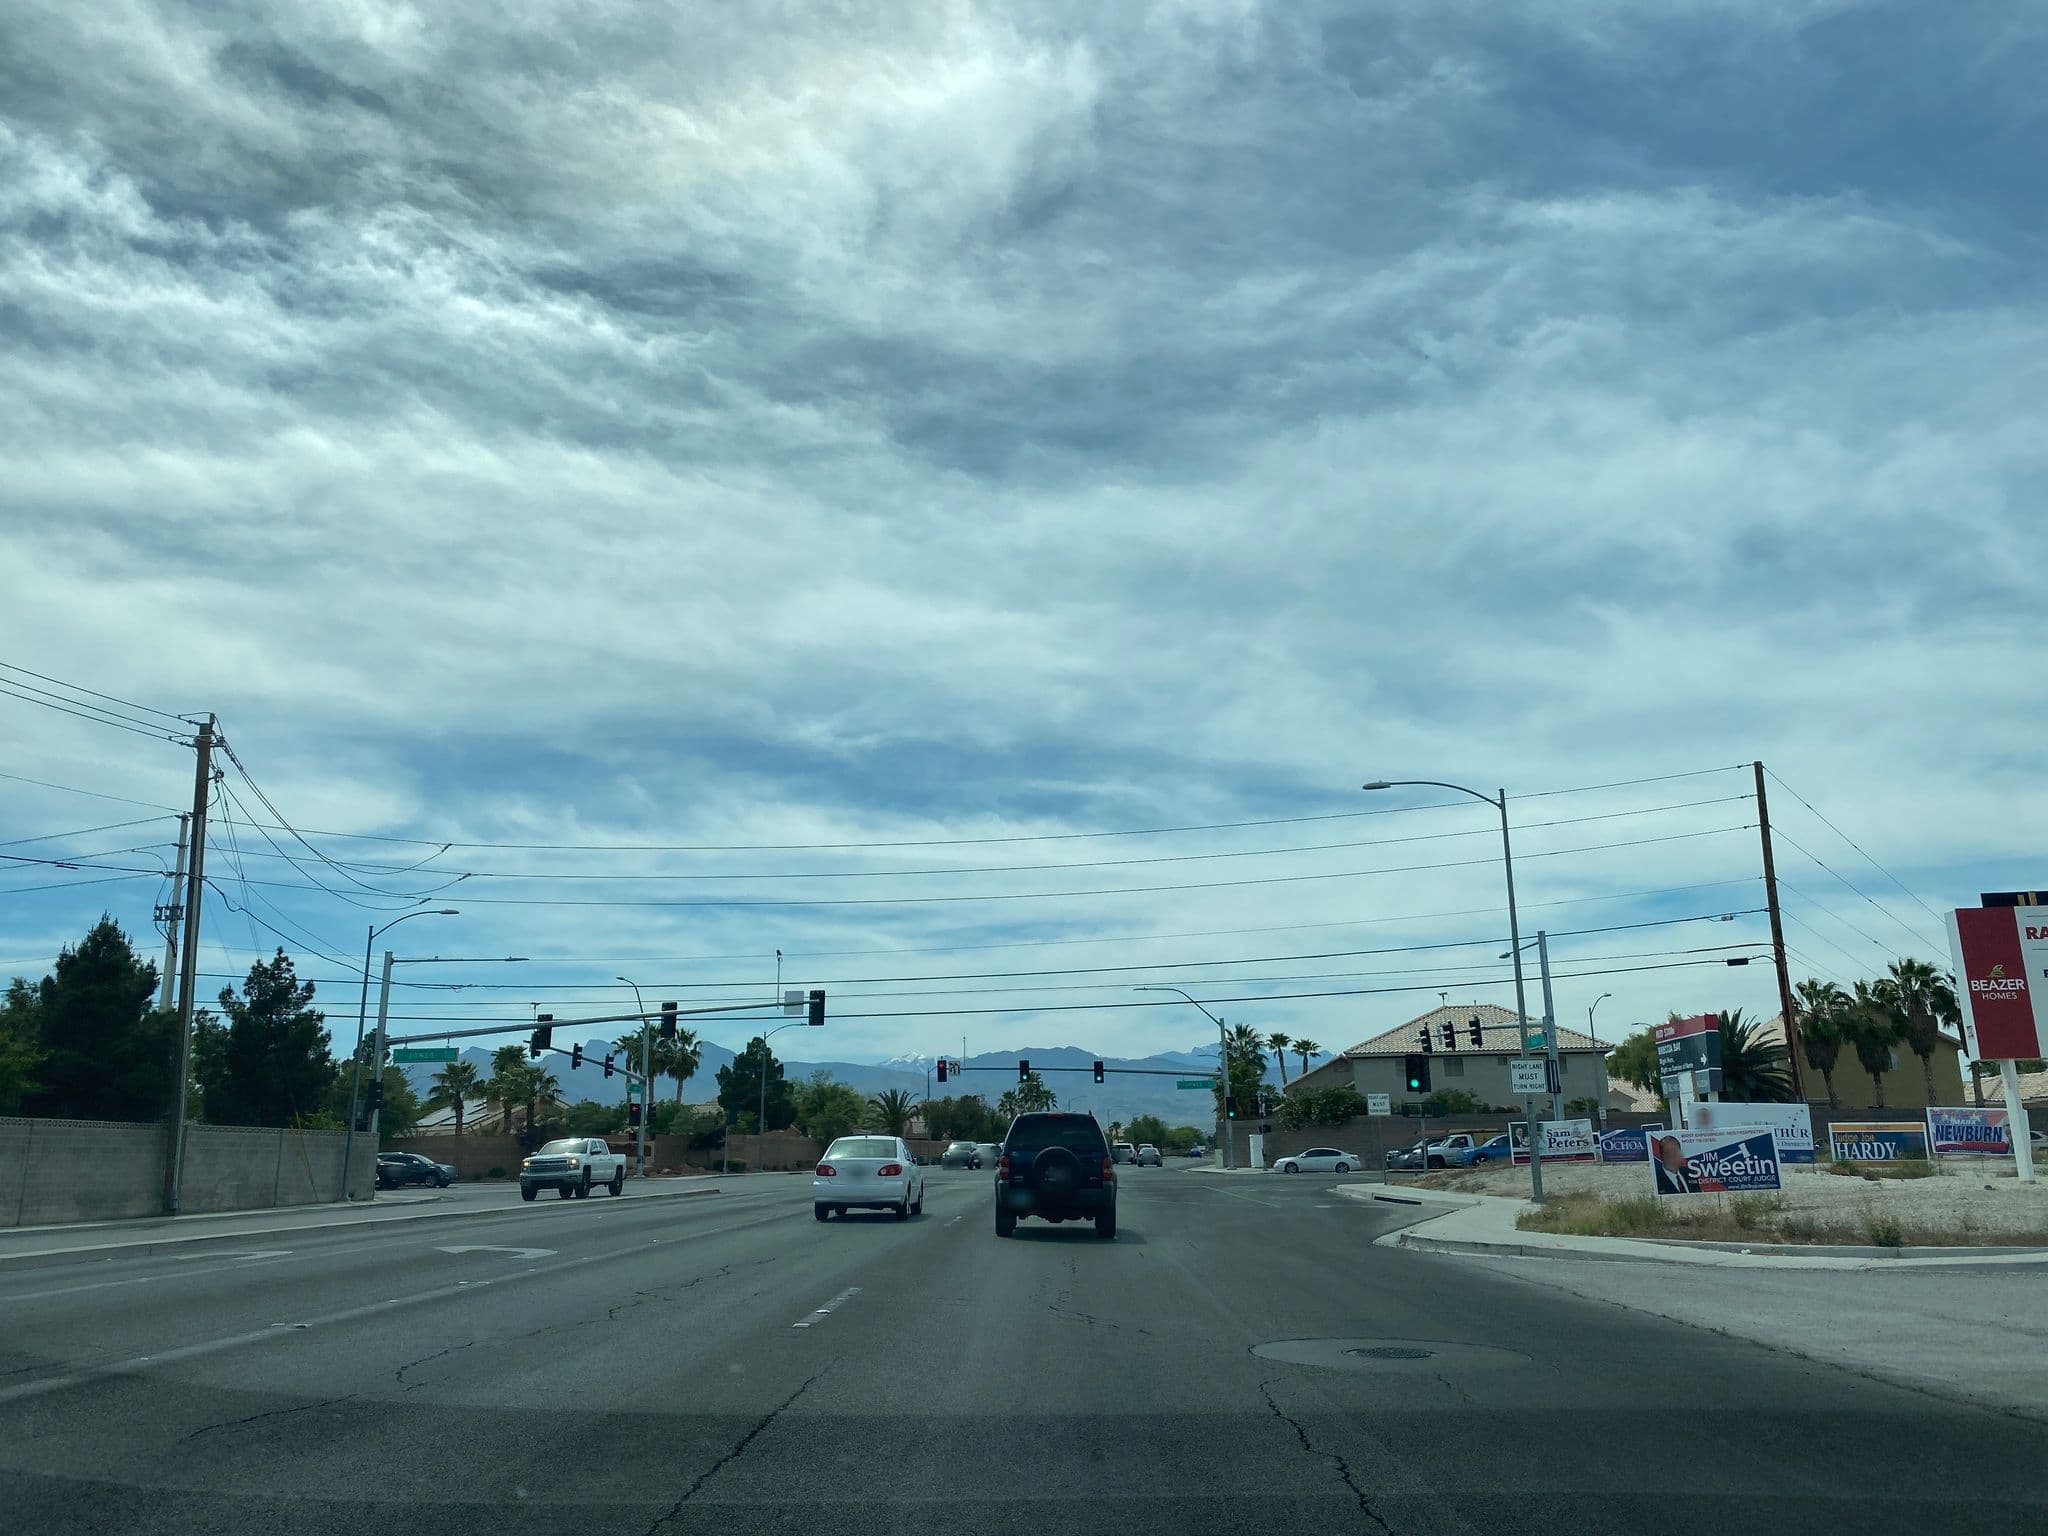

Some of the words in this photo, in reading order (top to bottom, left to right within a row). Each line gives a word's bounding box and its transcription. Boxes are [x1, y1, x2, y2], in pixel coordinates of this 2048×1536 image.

[1970, 978, 2026, 991] BEAZER
[1981, 991, 2018, 1000] HOMES
[1518, 1072, 1538, 1081] MUST
[1546, 1128, 1571, 1138] Sam
[1935, 1124, 2003, 1142] NEWBURN
[1548, 1137, 1590, 1149] Peters
[1602, 1139, 1645, 1151] OCHOA
[1701, 1151, 1719, 1162] JIM
[1834, 1142, 1897, 1160] HARDY
[1687, 1155, 1776, 1179] Sweetin
[1698, 1177, 1726, 1185] DISTRICT
[1753, 1174, 1777, 1182] JUDGE
